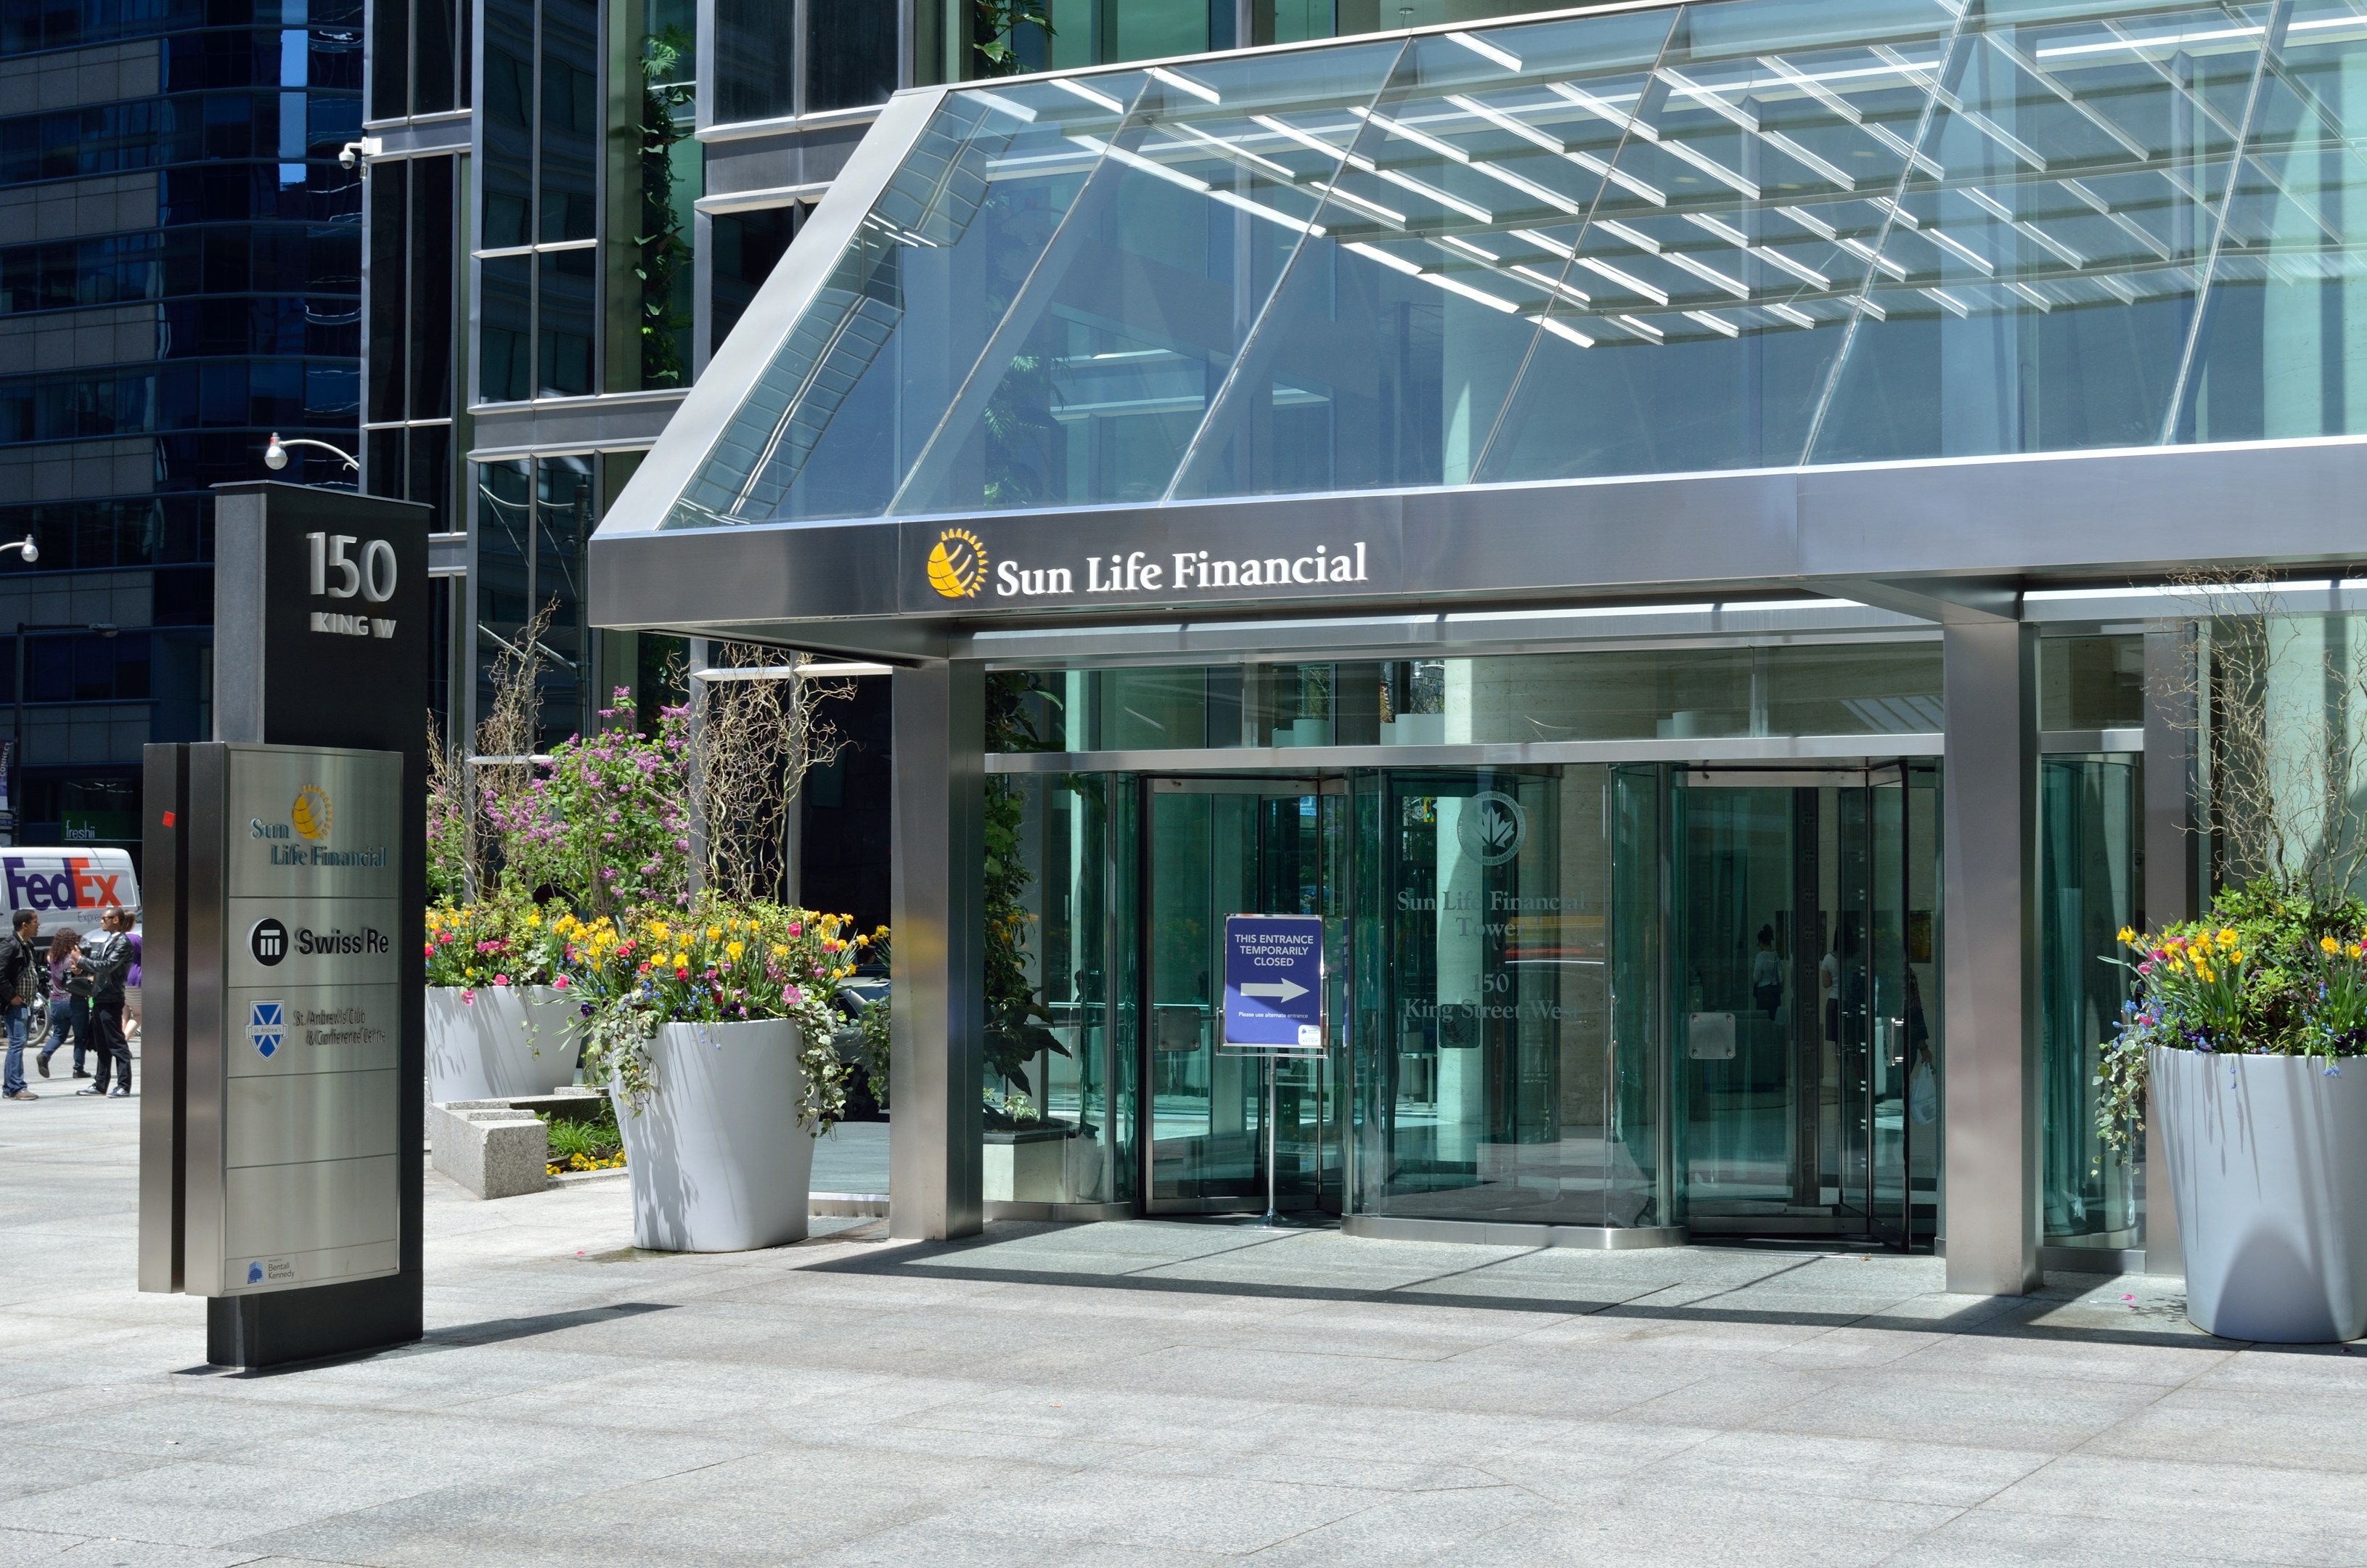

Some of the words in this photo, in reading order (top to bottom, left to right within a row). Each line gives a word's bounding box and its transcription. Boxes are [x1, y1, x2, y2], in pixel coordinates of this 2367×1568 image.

[306, 531, 398, 603] 150
[996, 560, 1074, 598] Sun
[1085, 550, 1163, 593] Life
[1172, 541, 1369, 589] Financial
[310, 611, 369, 636] KING
[370, 618, 397, 639] W
[65, 820, 95, 839] freshii
[250, 817, 290, 839] Sun
[270, 844, 308, 866] Life
[310, 845, 386, 867] Financial
[3, 857, 122, 911] FedEx
[1397, 891, 1436, 912] Sun
[1442, 891, 1482, 911] Life
[1489, 890, 1585, 911] Financial
[77, 911, 102, 924] Expres
[1455, 916, 1526, 937] Tower
[296, 927, 361, 955] Swiss
[364, 928, 389, 955] Re
[1235, 934, 1256, 943] THIS
[1259, 934, 1314, 944] ENTRANCE
[1240, 945, 1309, 955] TEMPORARILY
[1254, 957, 1294, 967] CLOSED
[1471, 973, 1510, 992] 150
[293, 1010, 306, 1026] St.
[307, 1008, 346, 1026] Andrew's
[346, 1007, 366, 1024] Club
[1404, 997, 1454, 1021] King
[1461, 998, 1521, 1018] Street
[306, 1029, 314, 1046] &
[314, 1028, 361, 1045] Conference
[360, 1026, 386, 1043] Centre
[269, 1262, 290, 1271] Bentall
[269, 1270, 295, 1279] Kennedy
